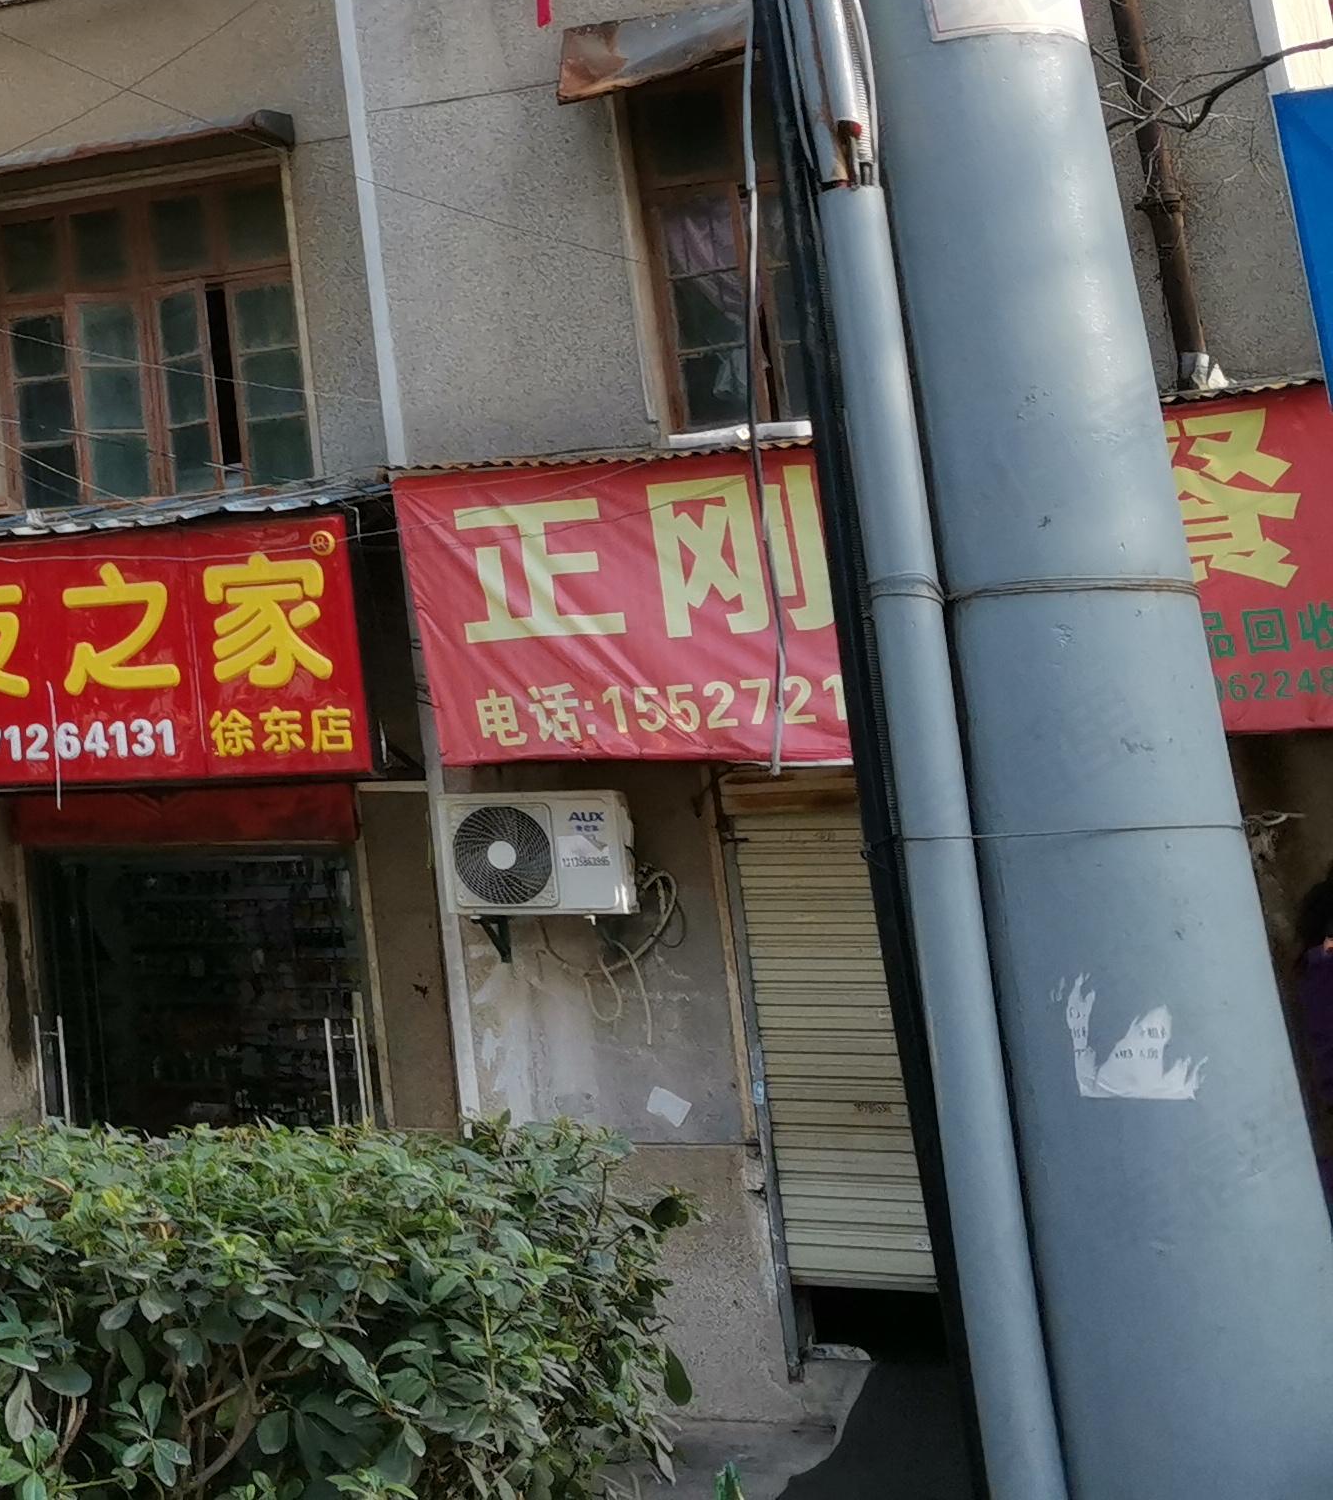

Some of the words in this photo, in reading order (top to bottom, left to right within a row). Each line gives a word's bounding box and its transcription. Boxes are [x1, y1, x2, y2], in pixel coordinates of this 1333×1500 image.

[210, 706, 353, 757] 徐东店
[569, 811, 605, 823] AUX
